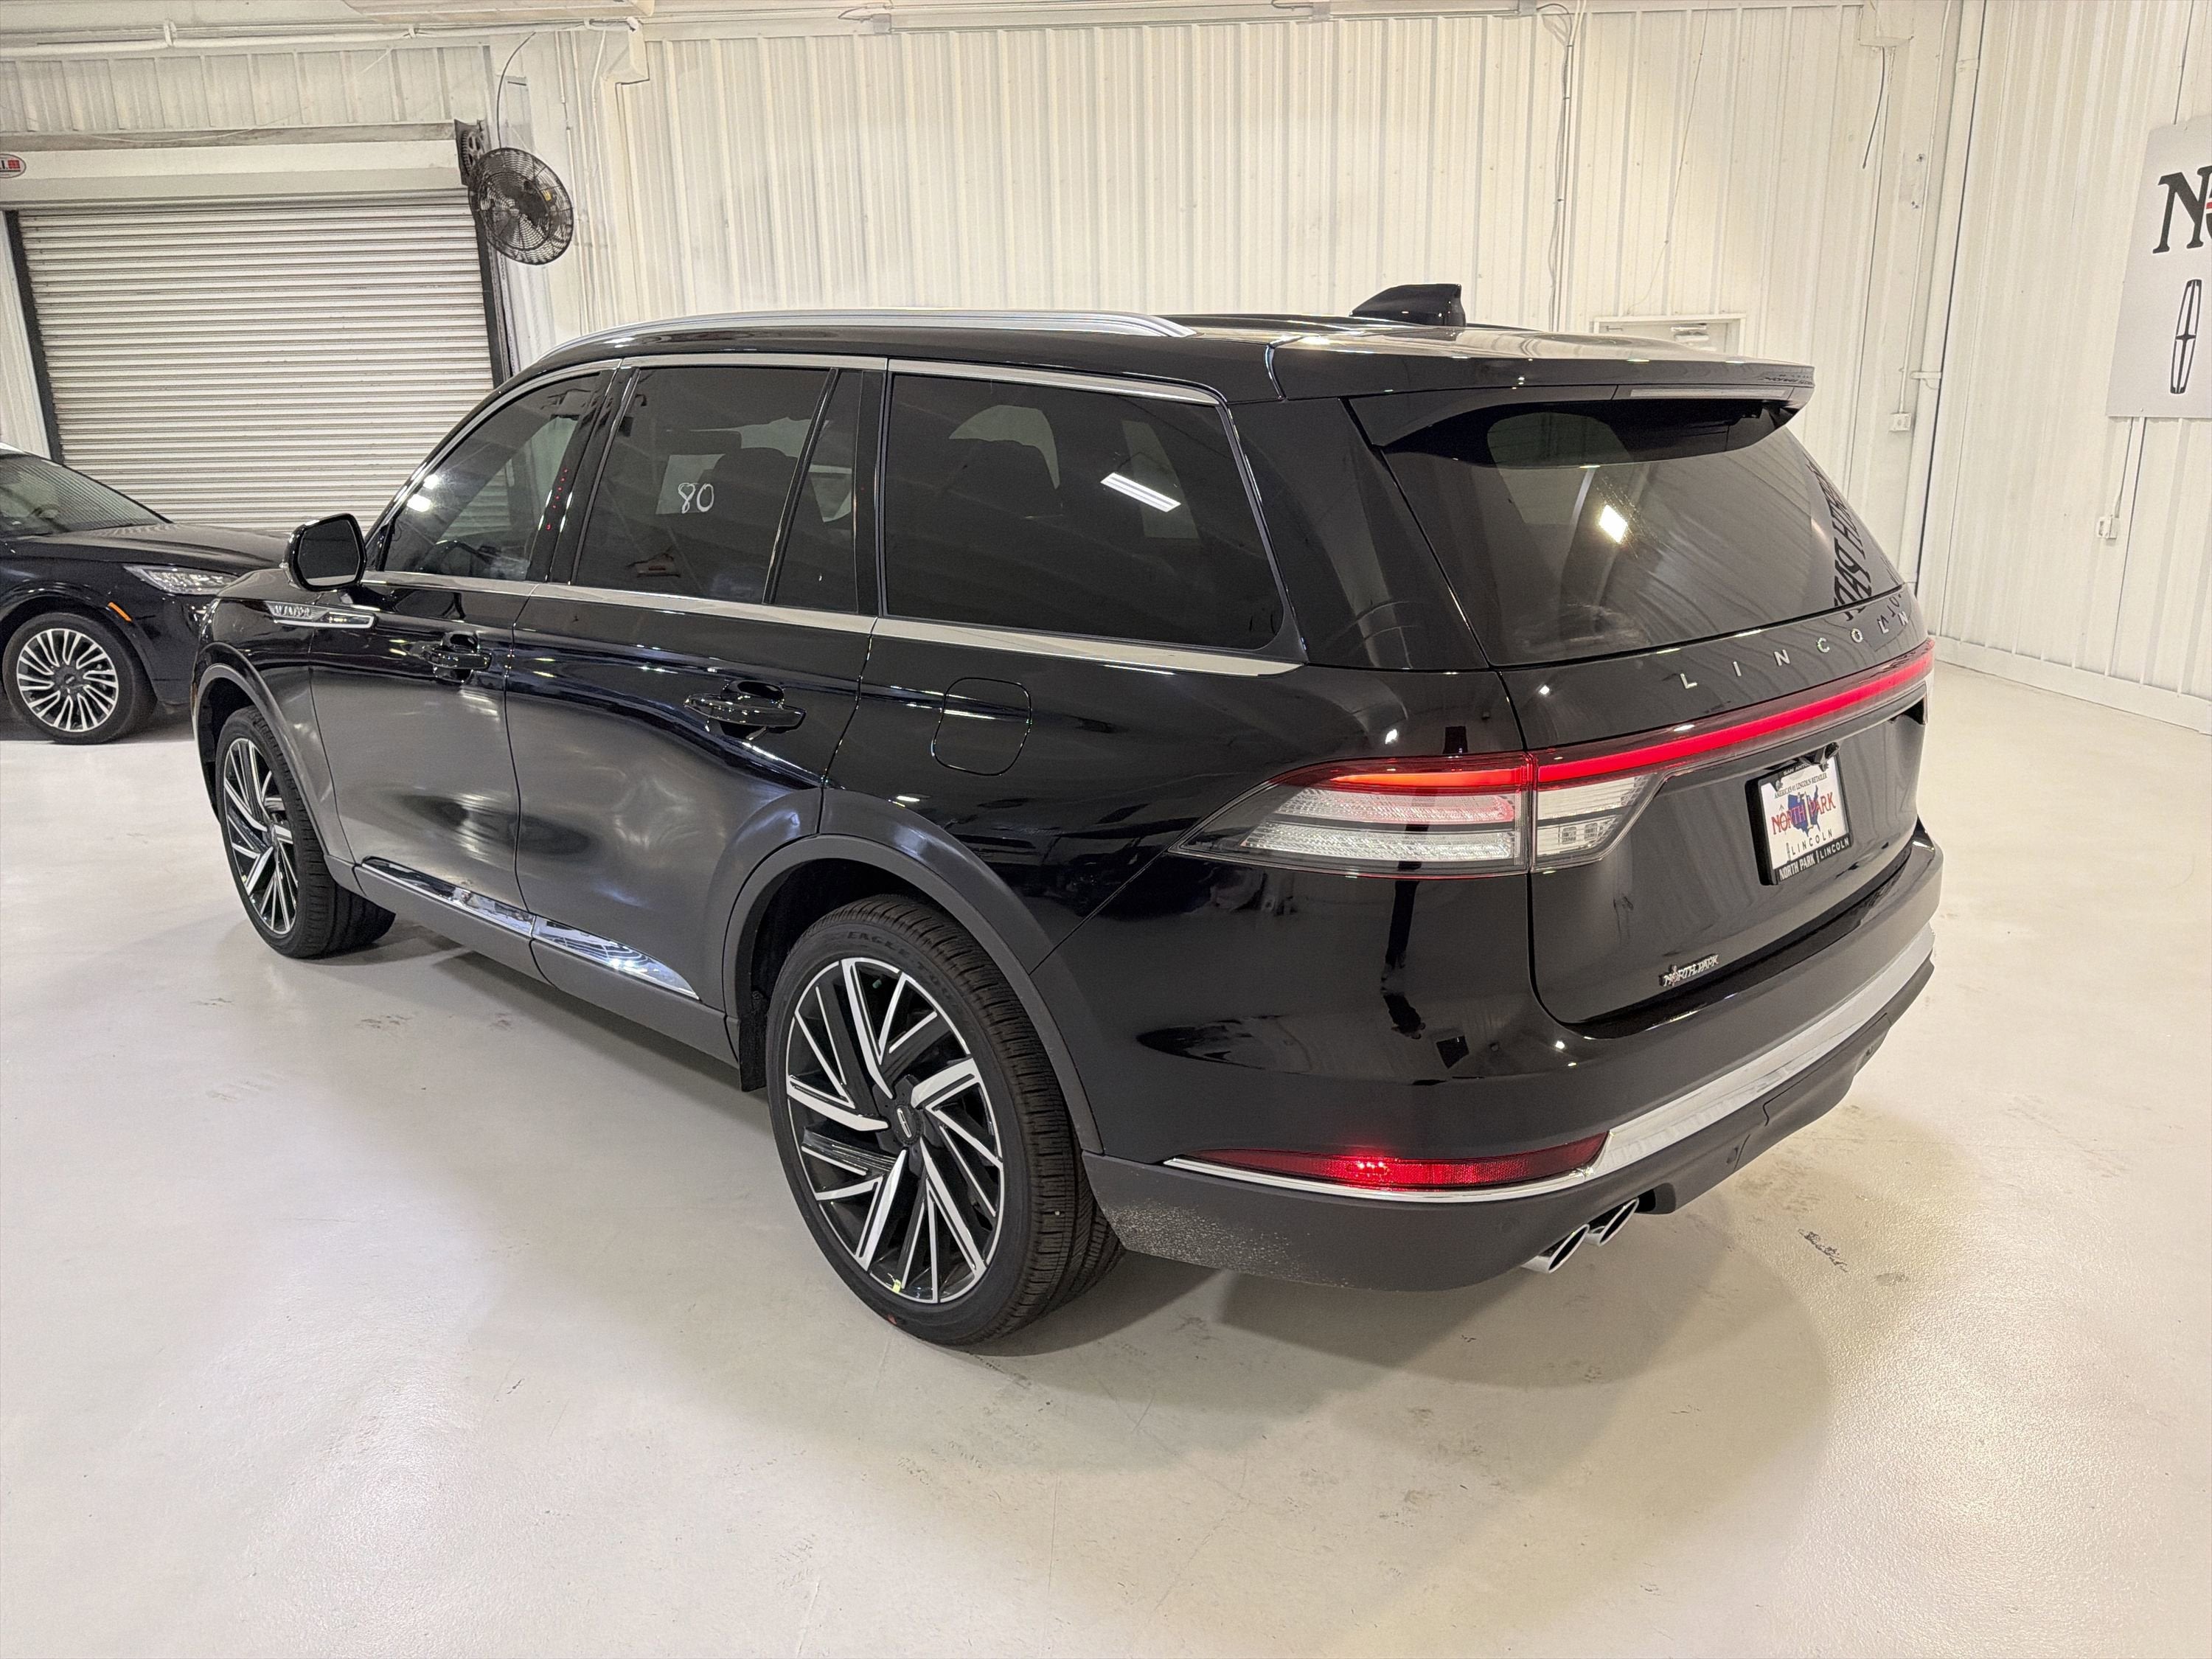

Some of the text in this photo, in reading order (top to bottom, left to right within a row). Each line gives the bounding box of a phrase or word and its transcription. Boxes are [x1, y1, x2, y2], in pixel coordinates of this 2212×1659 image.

[678, 482, 714, 514] 80
[1679, 610, 1910, 689] LINCOLN
[1771, 792, 1836, 835] NORTH PARK
[1778, 837, 1850, 881] NORTH PARK LINCOLN
[1792, 828, 1834, 856] LINCOLN
[1663, 954, 1719, 987] NORTH PARK
